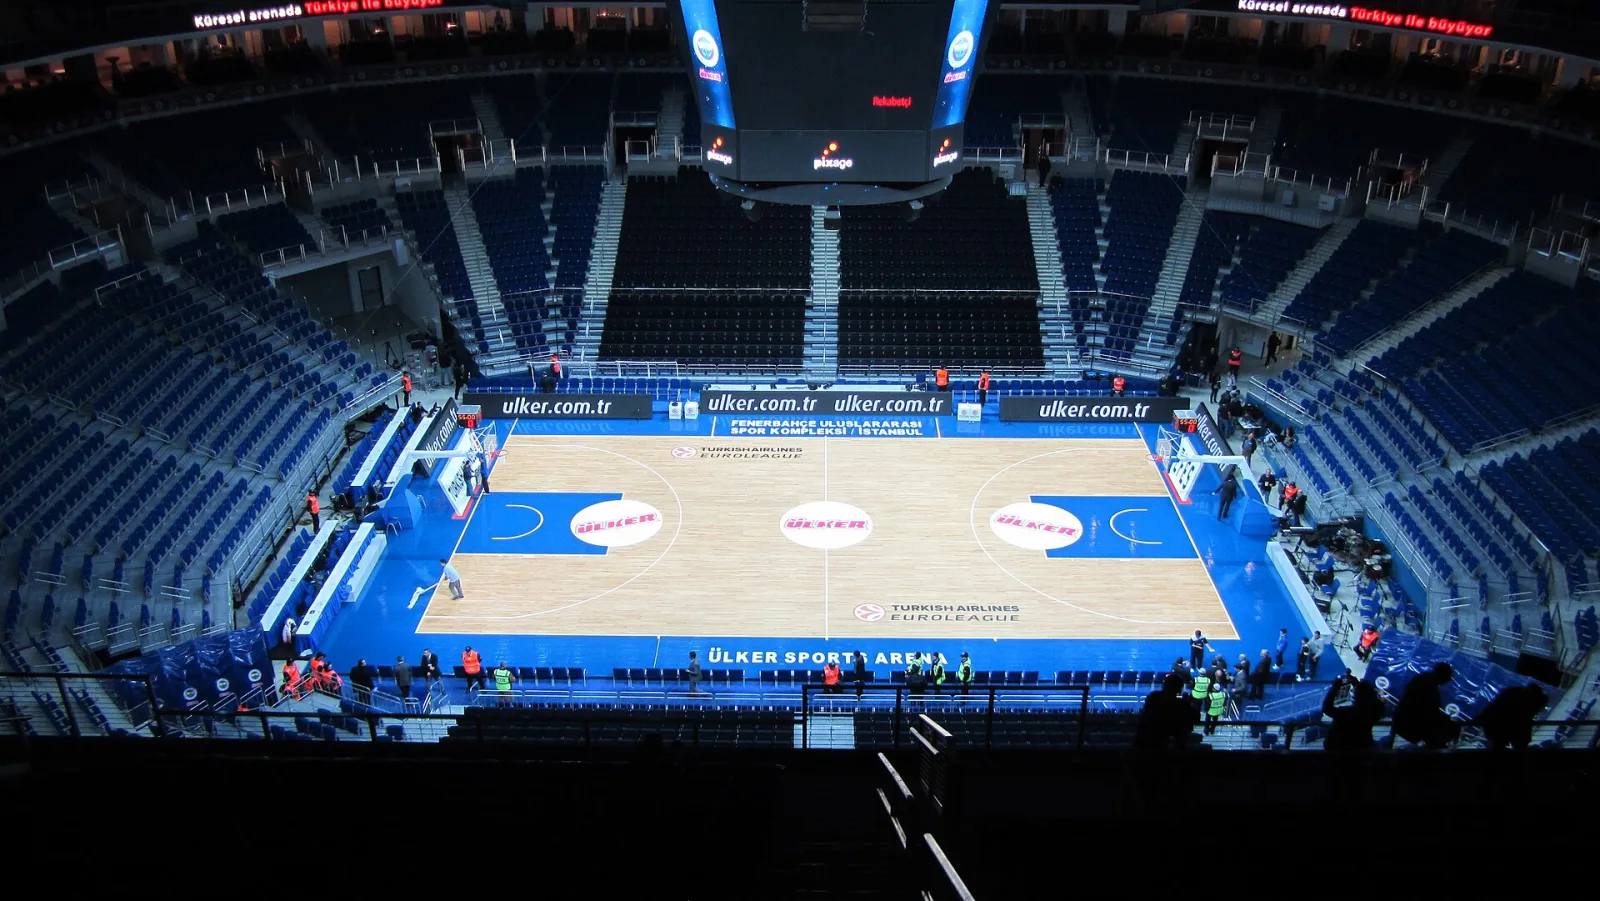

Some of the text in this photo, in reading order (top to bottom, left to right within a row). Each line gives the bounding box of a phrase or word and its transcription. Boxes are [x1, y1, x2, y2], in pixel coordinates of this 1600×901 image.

[193, 12, 246, 28] Küresel
[249, 6, 302, 21] arenada
[1238, 0, 1288, 13] Küresel
[1291, 4, 1347, 18] arenada
[1350, 6, 1402, 24] Türkiye
[1428, 18, 1493, 37] büyüyor
[872, 96, 912, 109] Rekabetçi
[707, 149, 733, 165] pixage
[813, 156, 853, 170] pixage
[933, 151, 958, 167] pixage
[502, 397, 612, 415] ulker.com.tr
[708, 394, 818, 411] ulker.com.tr
[834, 395, 944, 412] ulker.com.tr
[1039, 400, 1150, 418] ulker.com.tr
[730, 427, 766, 435] SPOR
[770, 426, 847, 435] KOMPLEKSİ
[858, 426, 923, 436] İSTANBUL
[731, 419, 922, 429] FENERBAHÇE ULUSLARARASI
[575, 512, 657, 535] ÜLKER
[783, 517, 869, 532] ÜLKER
[995, 514, 1078, 537] ÜLKER
[892, 604, 954, 612] TURKISH
[708, 647, 777, 665] ÜLKER
